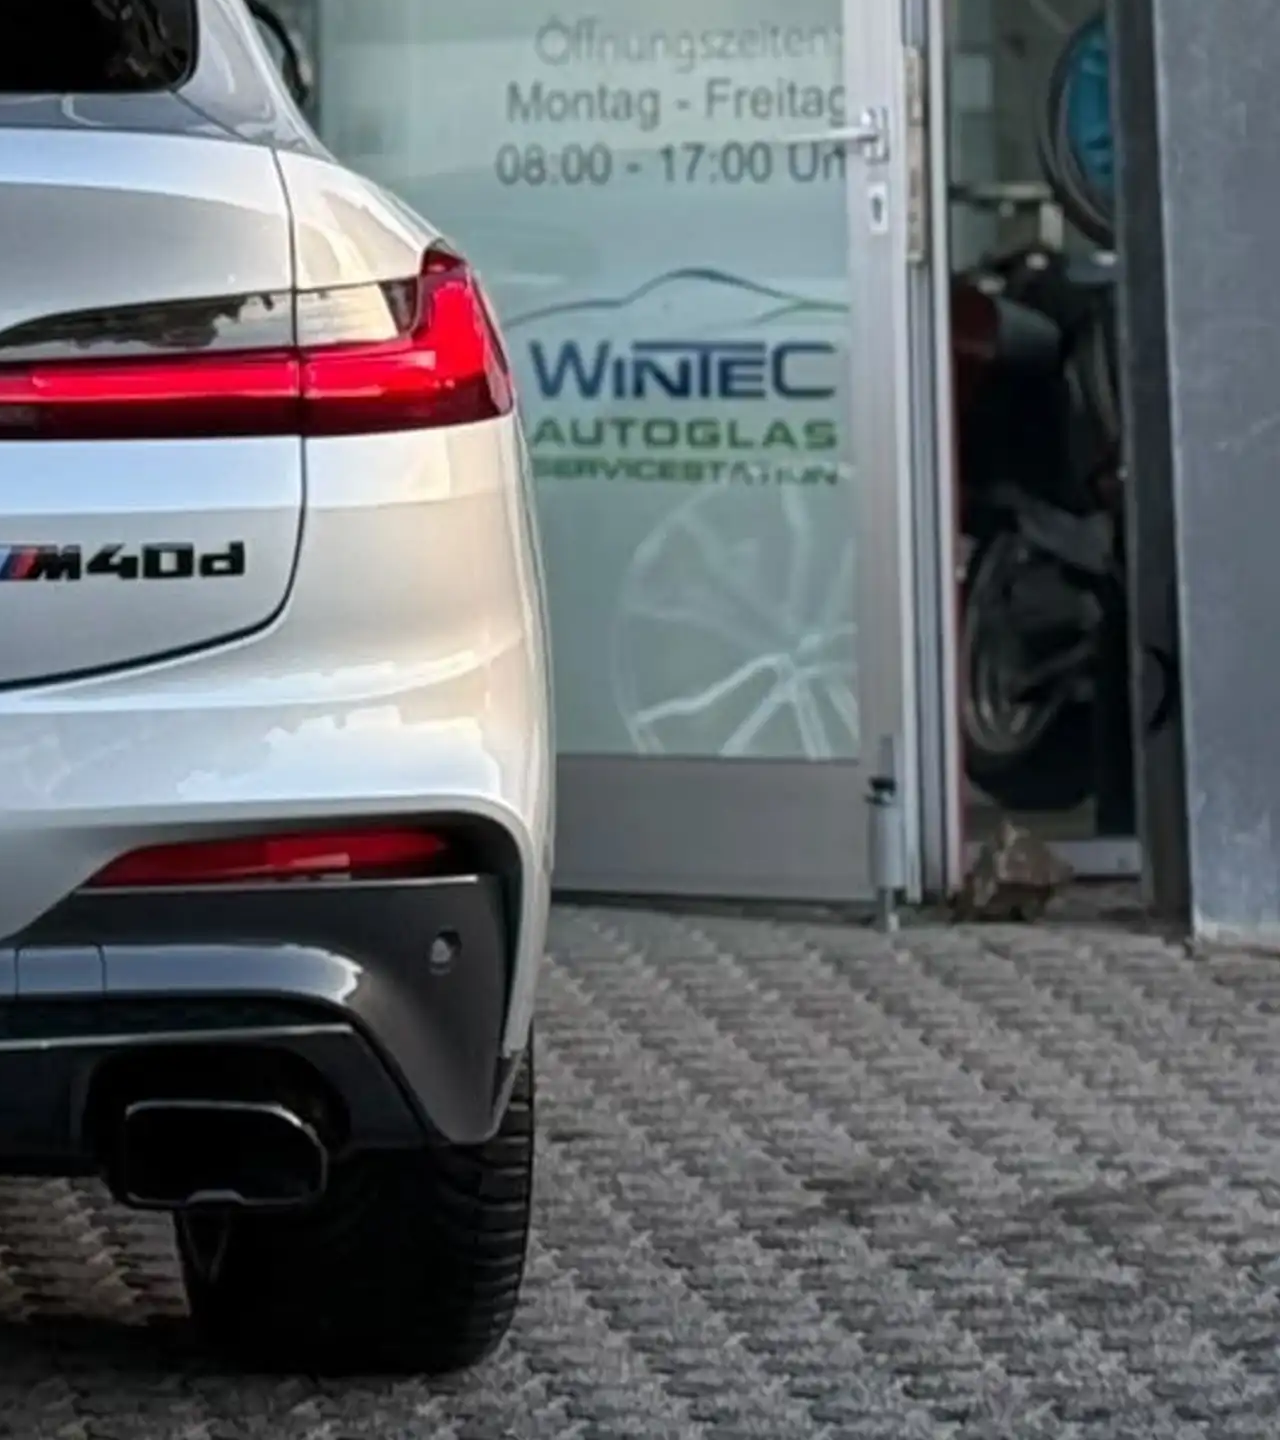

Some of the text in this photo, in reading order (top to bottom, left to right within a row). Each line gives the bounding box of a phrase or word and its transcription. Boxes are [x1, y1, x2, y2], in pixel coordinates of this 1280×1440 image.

[507, 82, 661, 130] Montag
[496, 142, 613, 185] 08:00
[660, 141, 773, 184] 17:00
[535, 417, 838, 449] AUTOGLAS
